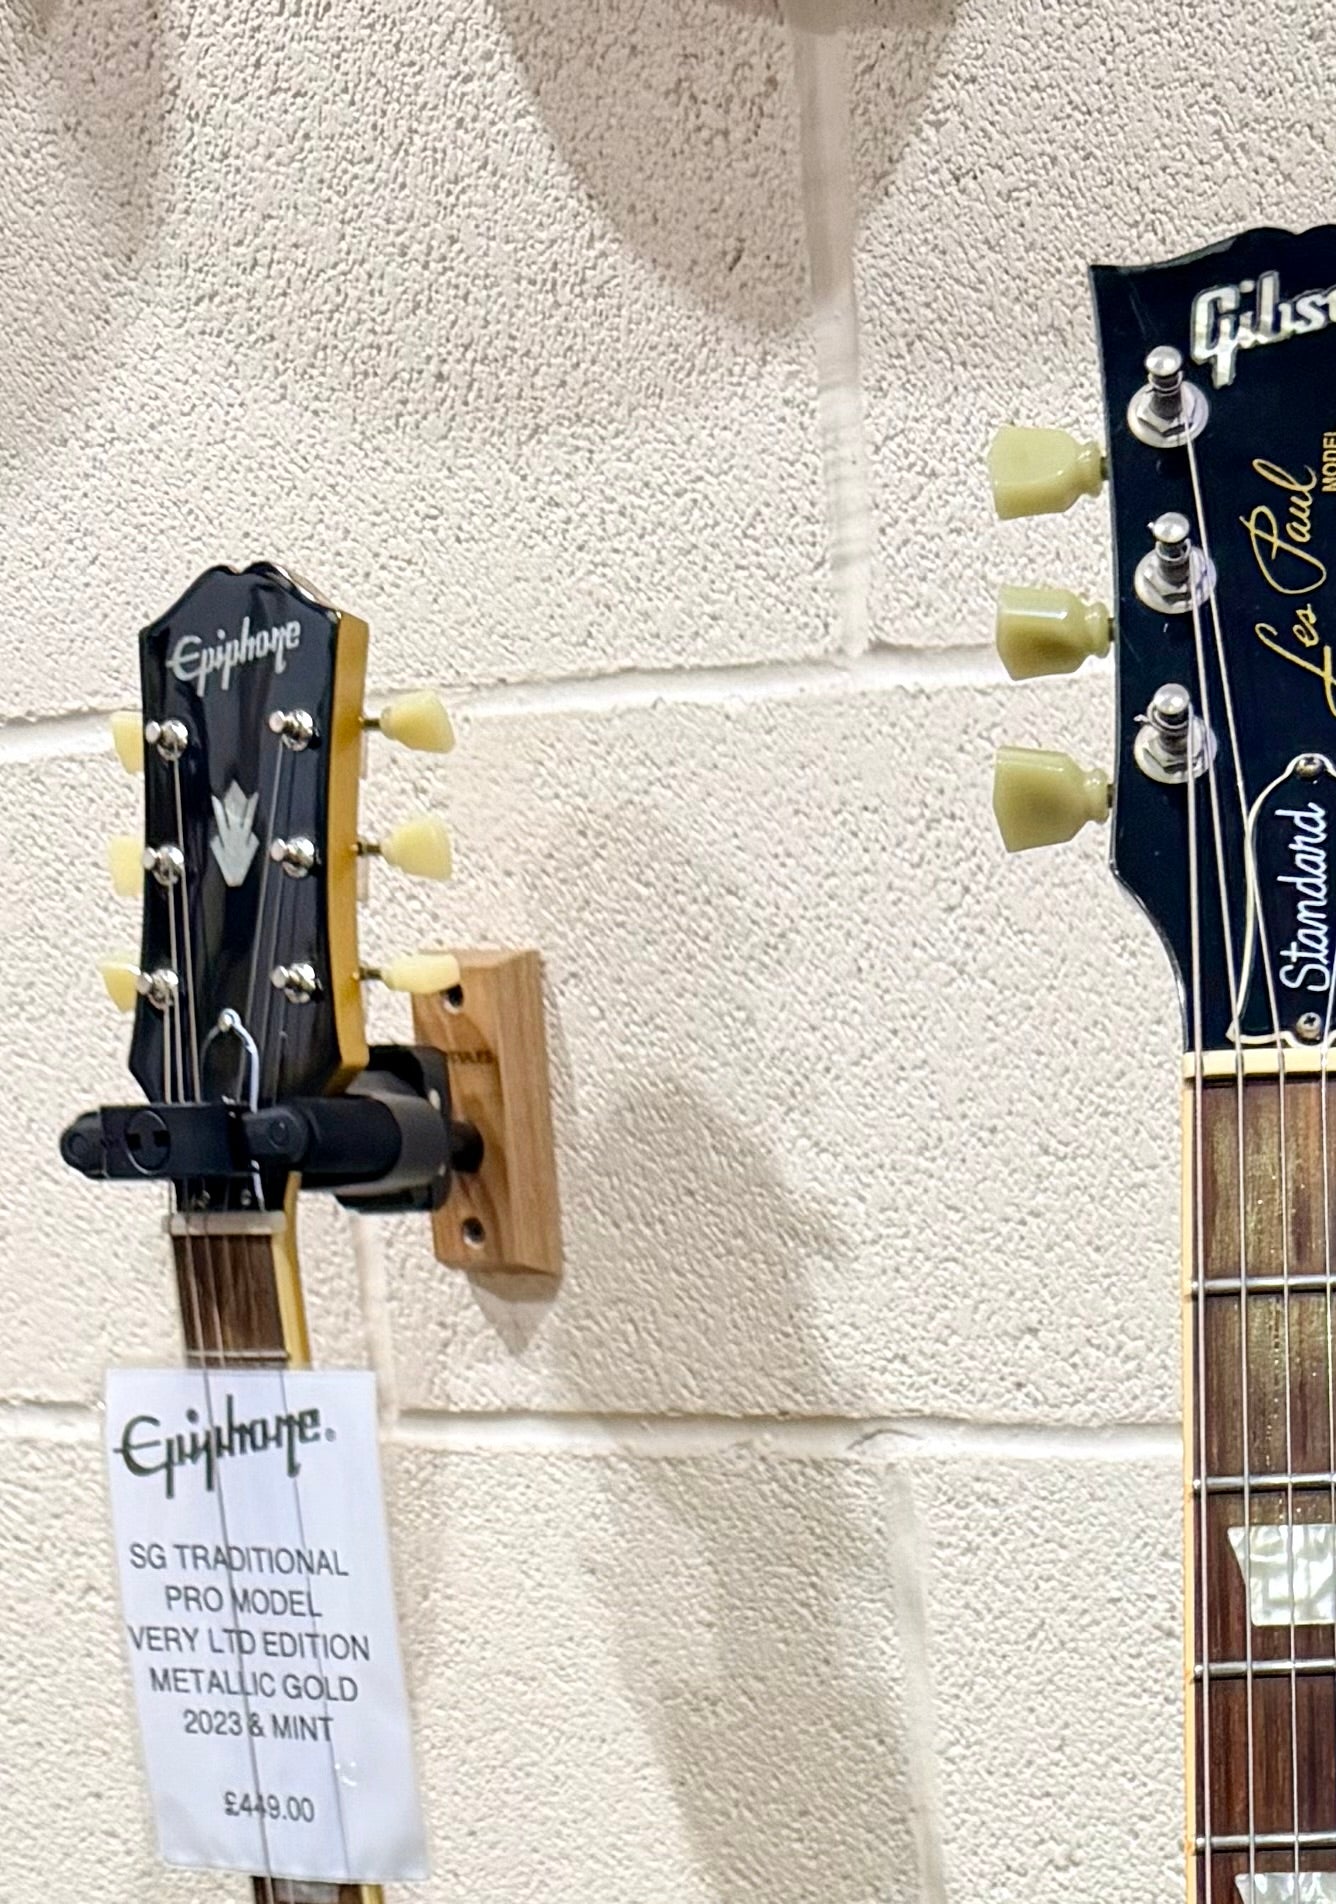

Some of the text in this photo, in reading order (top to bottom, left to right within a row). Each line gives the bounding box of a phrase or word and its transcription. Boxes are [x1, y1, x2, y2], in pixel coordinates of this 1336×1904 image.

[1239, 458, 1327, 594] Paul
[166, 617, 301, 697] Epiphone
[1277, 803, 1328, 992] Standard
[129, 1543, 349, 1576] SG TRADITIONAL
[165, 1586, 322, 1617] PRO MODEL
[127, 1625, 370, 1661] VERY LTD EDITION
[150, 1668, 359, 1702] METALLIC GOLD
[184, 1709, 334, 1742] 2023 & MINT
[224, 1792, 315, 1823] £449.00
